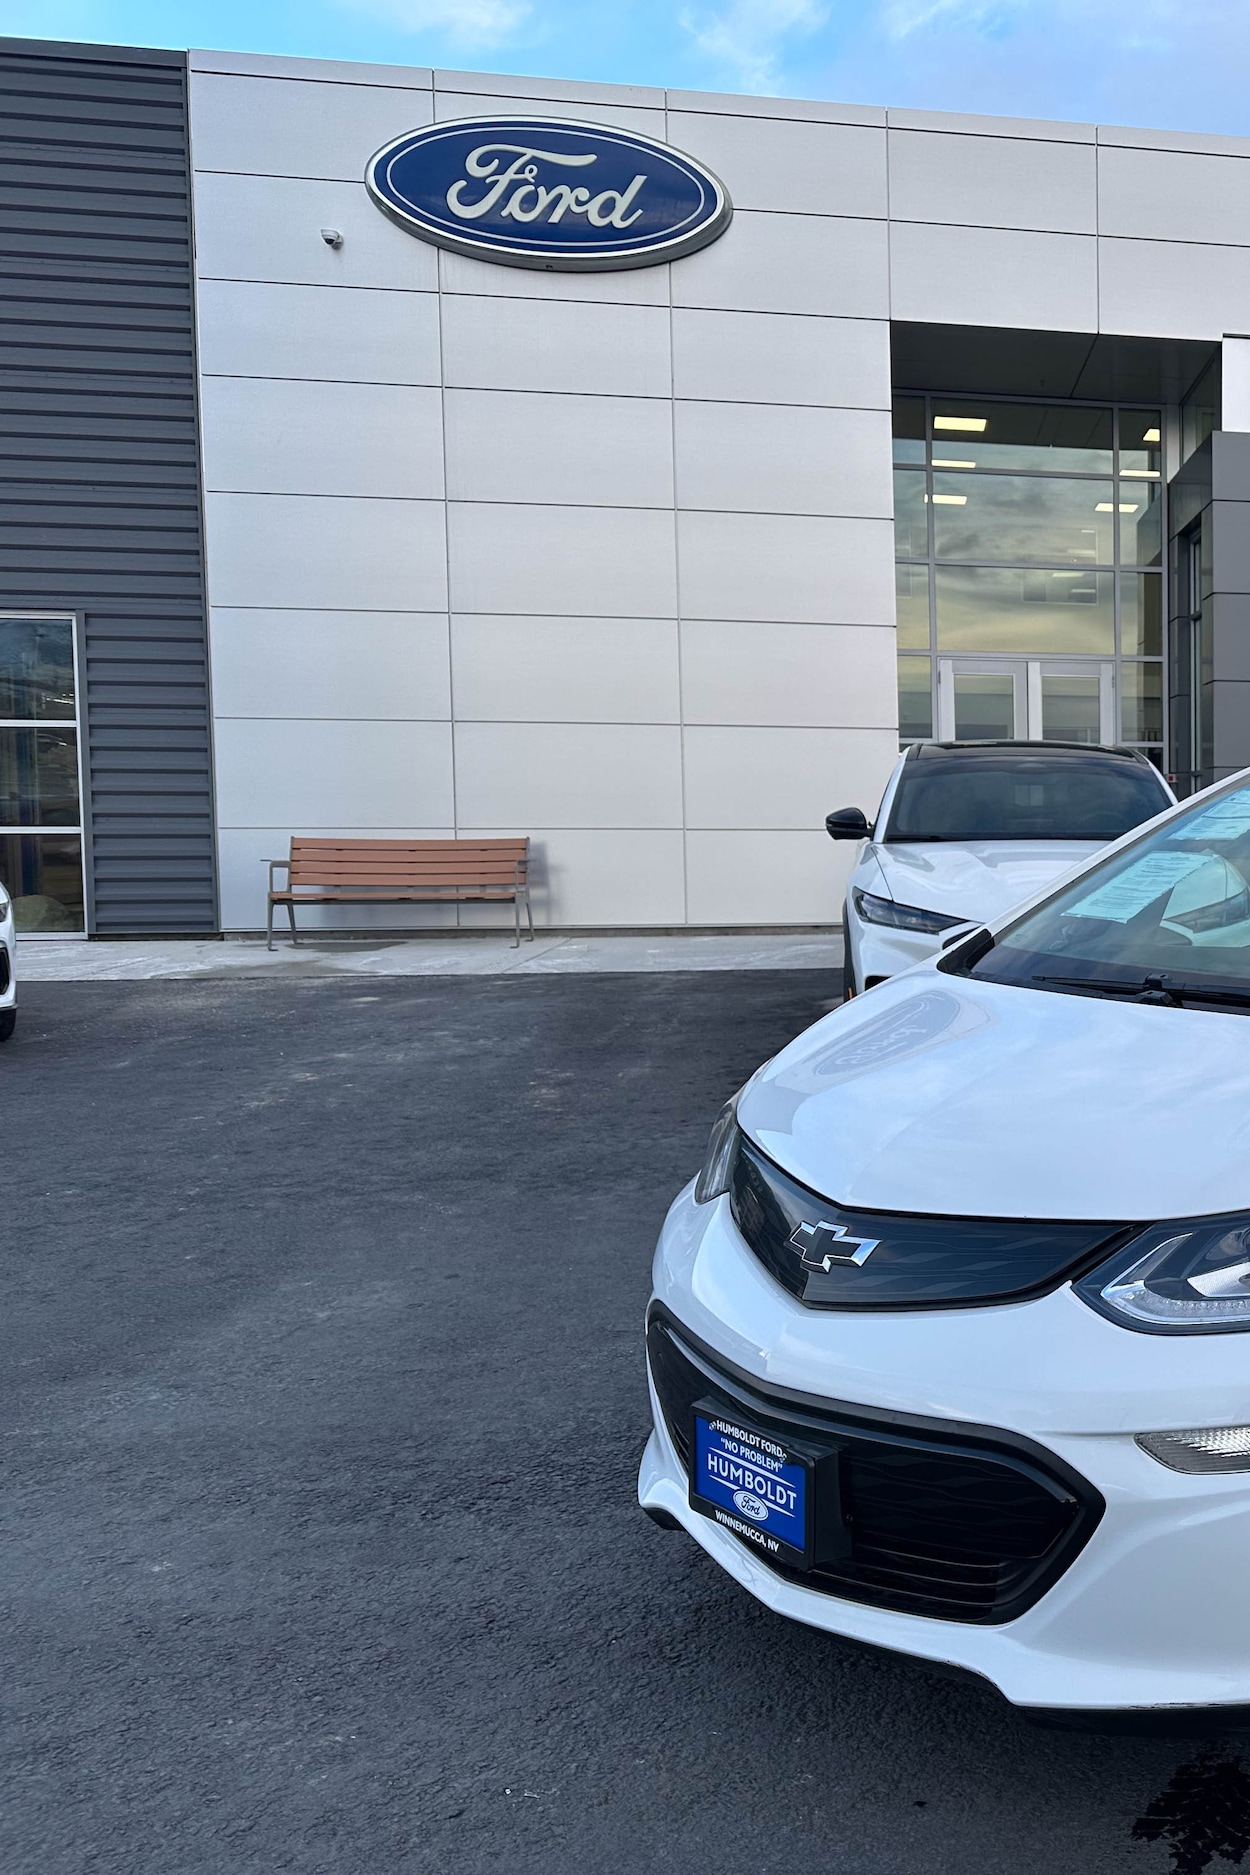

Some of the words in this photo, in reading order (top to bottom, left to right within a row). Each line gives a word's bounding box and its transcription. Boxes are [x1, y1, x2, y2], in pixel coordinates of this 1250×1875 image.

[445, 143, 647, 229] Ford
[717, 1419, 762, 1447] HUMBOLDT
[761, 1438, 783, 1458] FORD
[707, 1453, 797, 1510] HUMBOLDT
[741, 1495, 761, 1516] Ford
[715, 1509, 767, 1548] WINNEMUCCA,
[767, 1538, 780, 1553] NV
